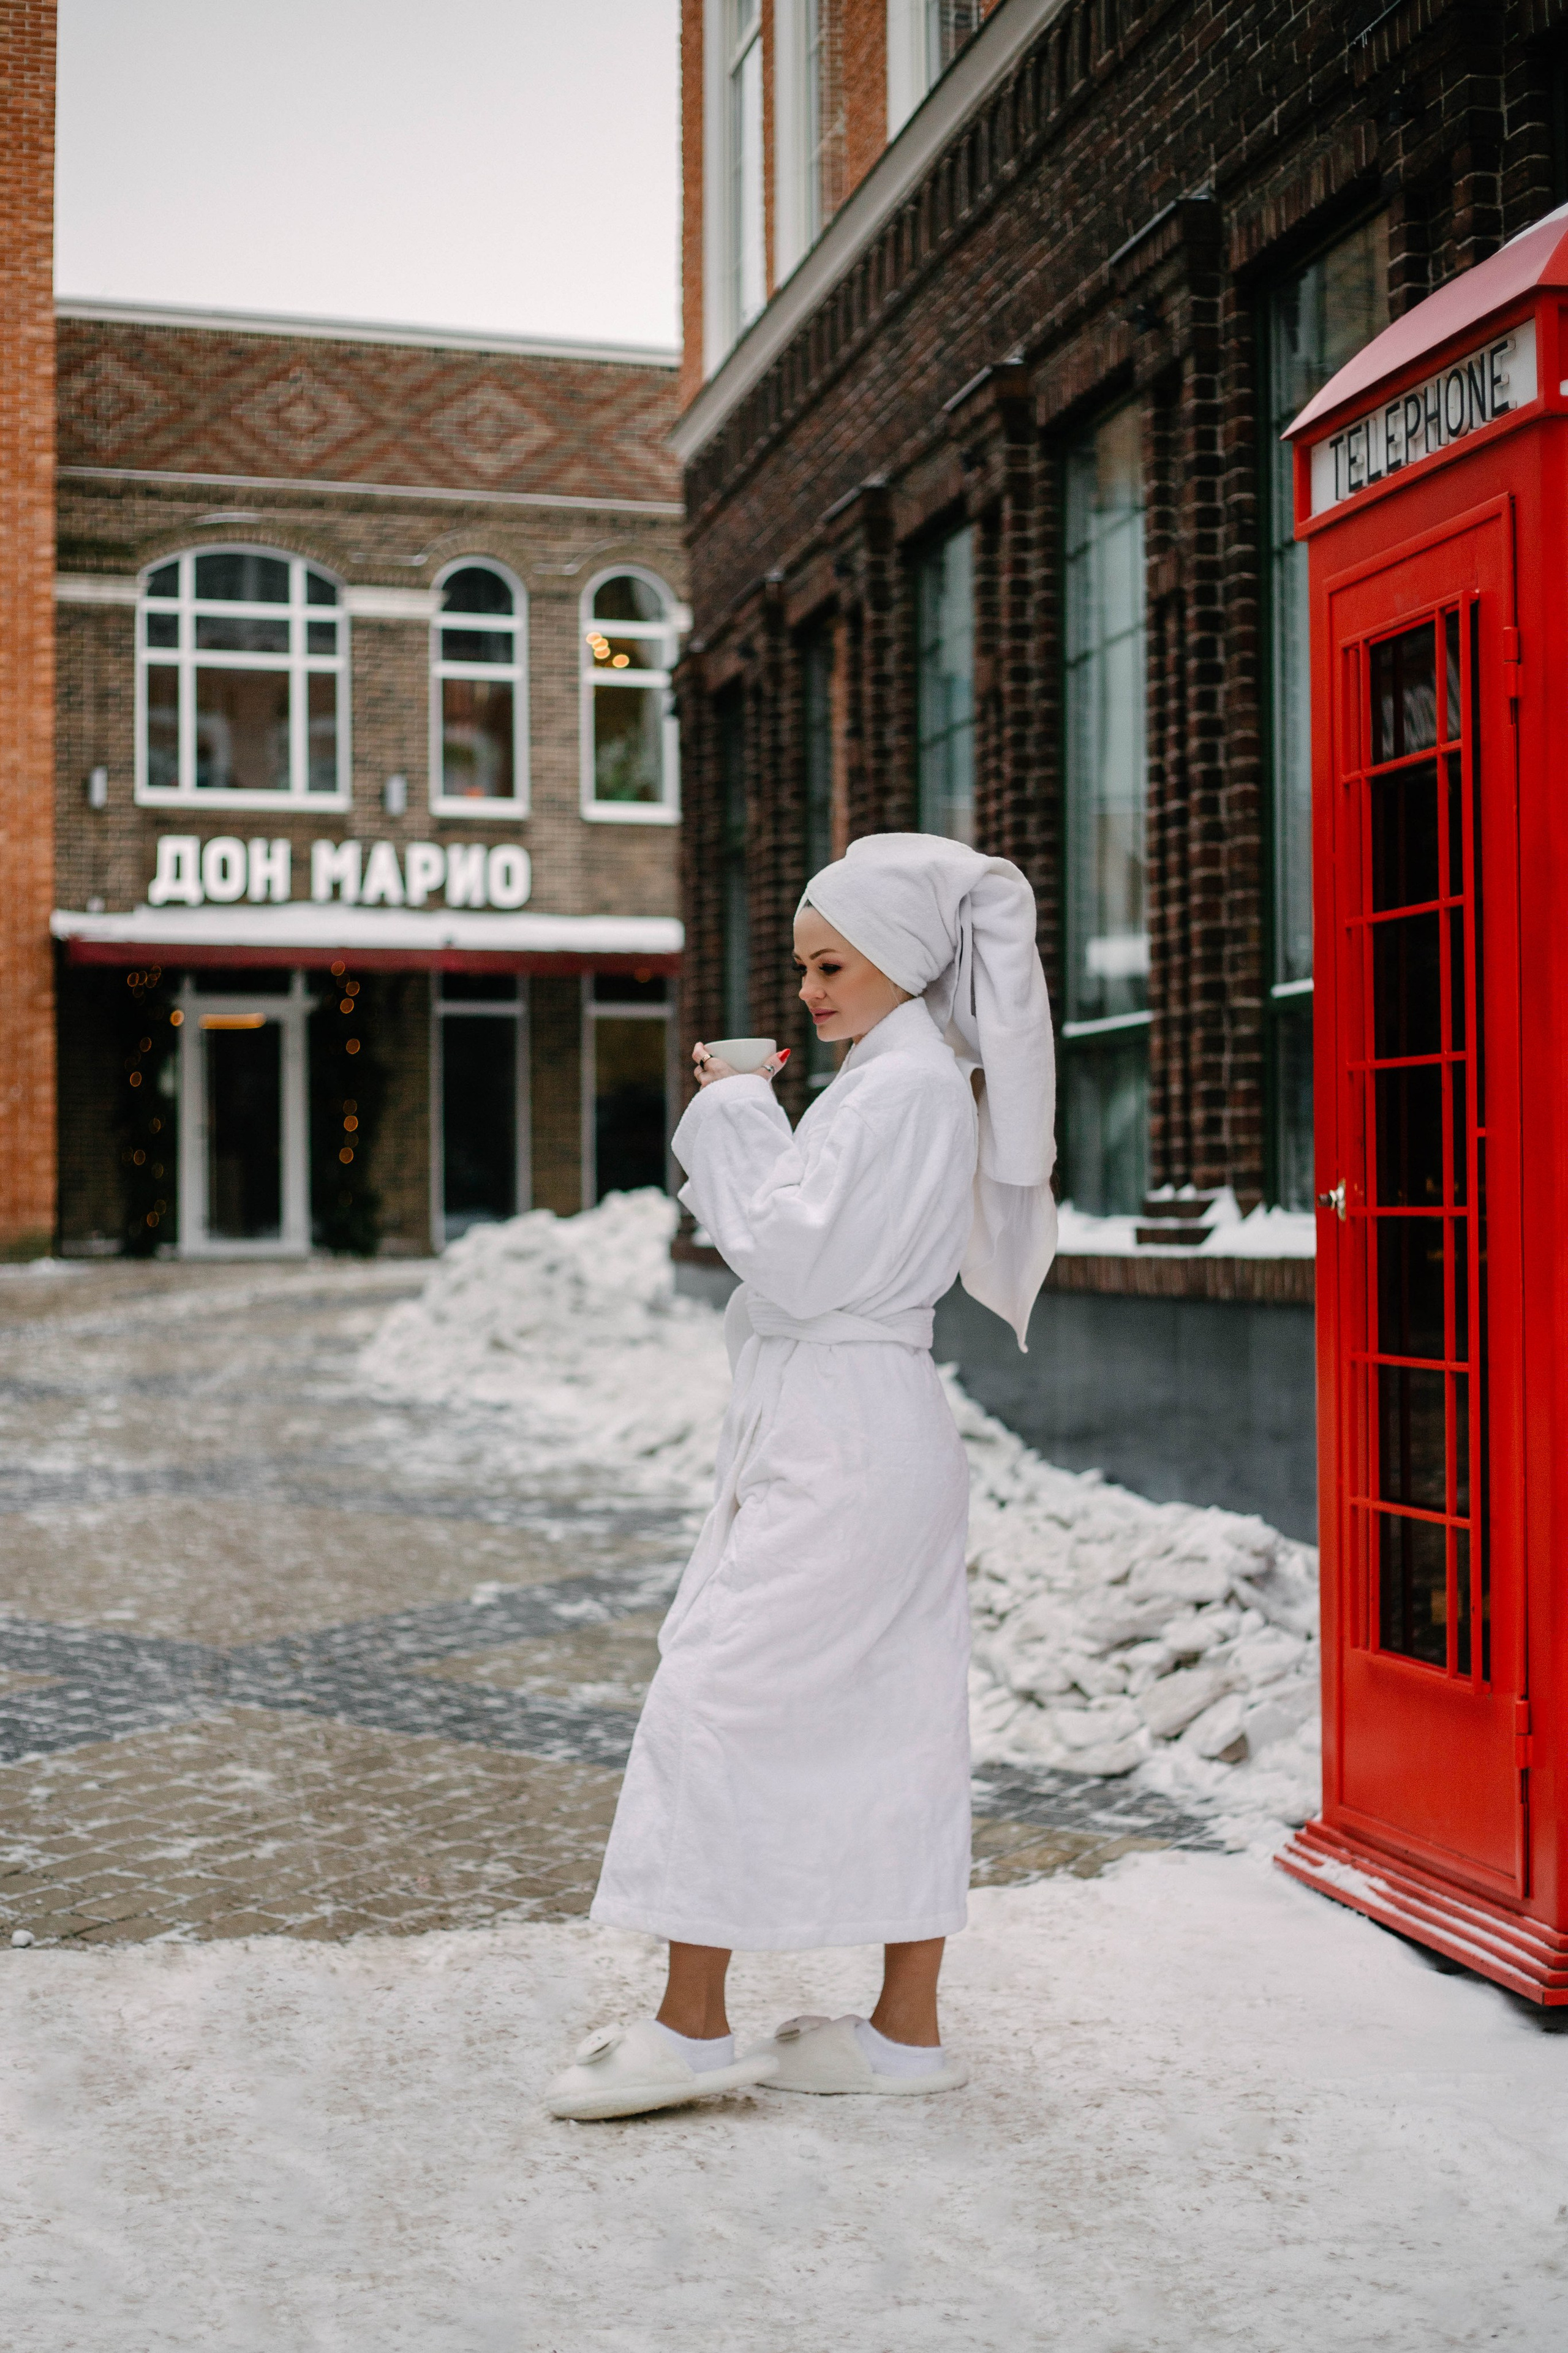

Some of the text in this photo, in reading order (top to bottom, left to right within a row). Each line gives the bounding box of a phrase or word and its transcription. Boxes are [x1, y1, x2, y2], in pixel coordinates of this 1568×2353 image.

[1330, 339, 1516, 501] TELEPHONE
[149, 835, 532, 910] ДОН МАРИО
